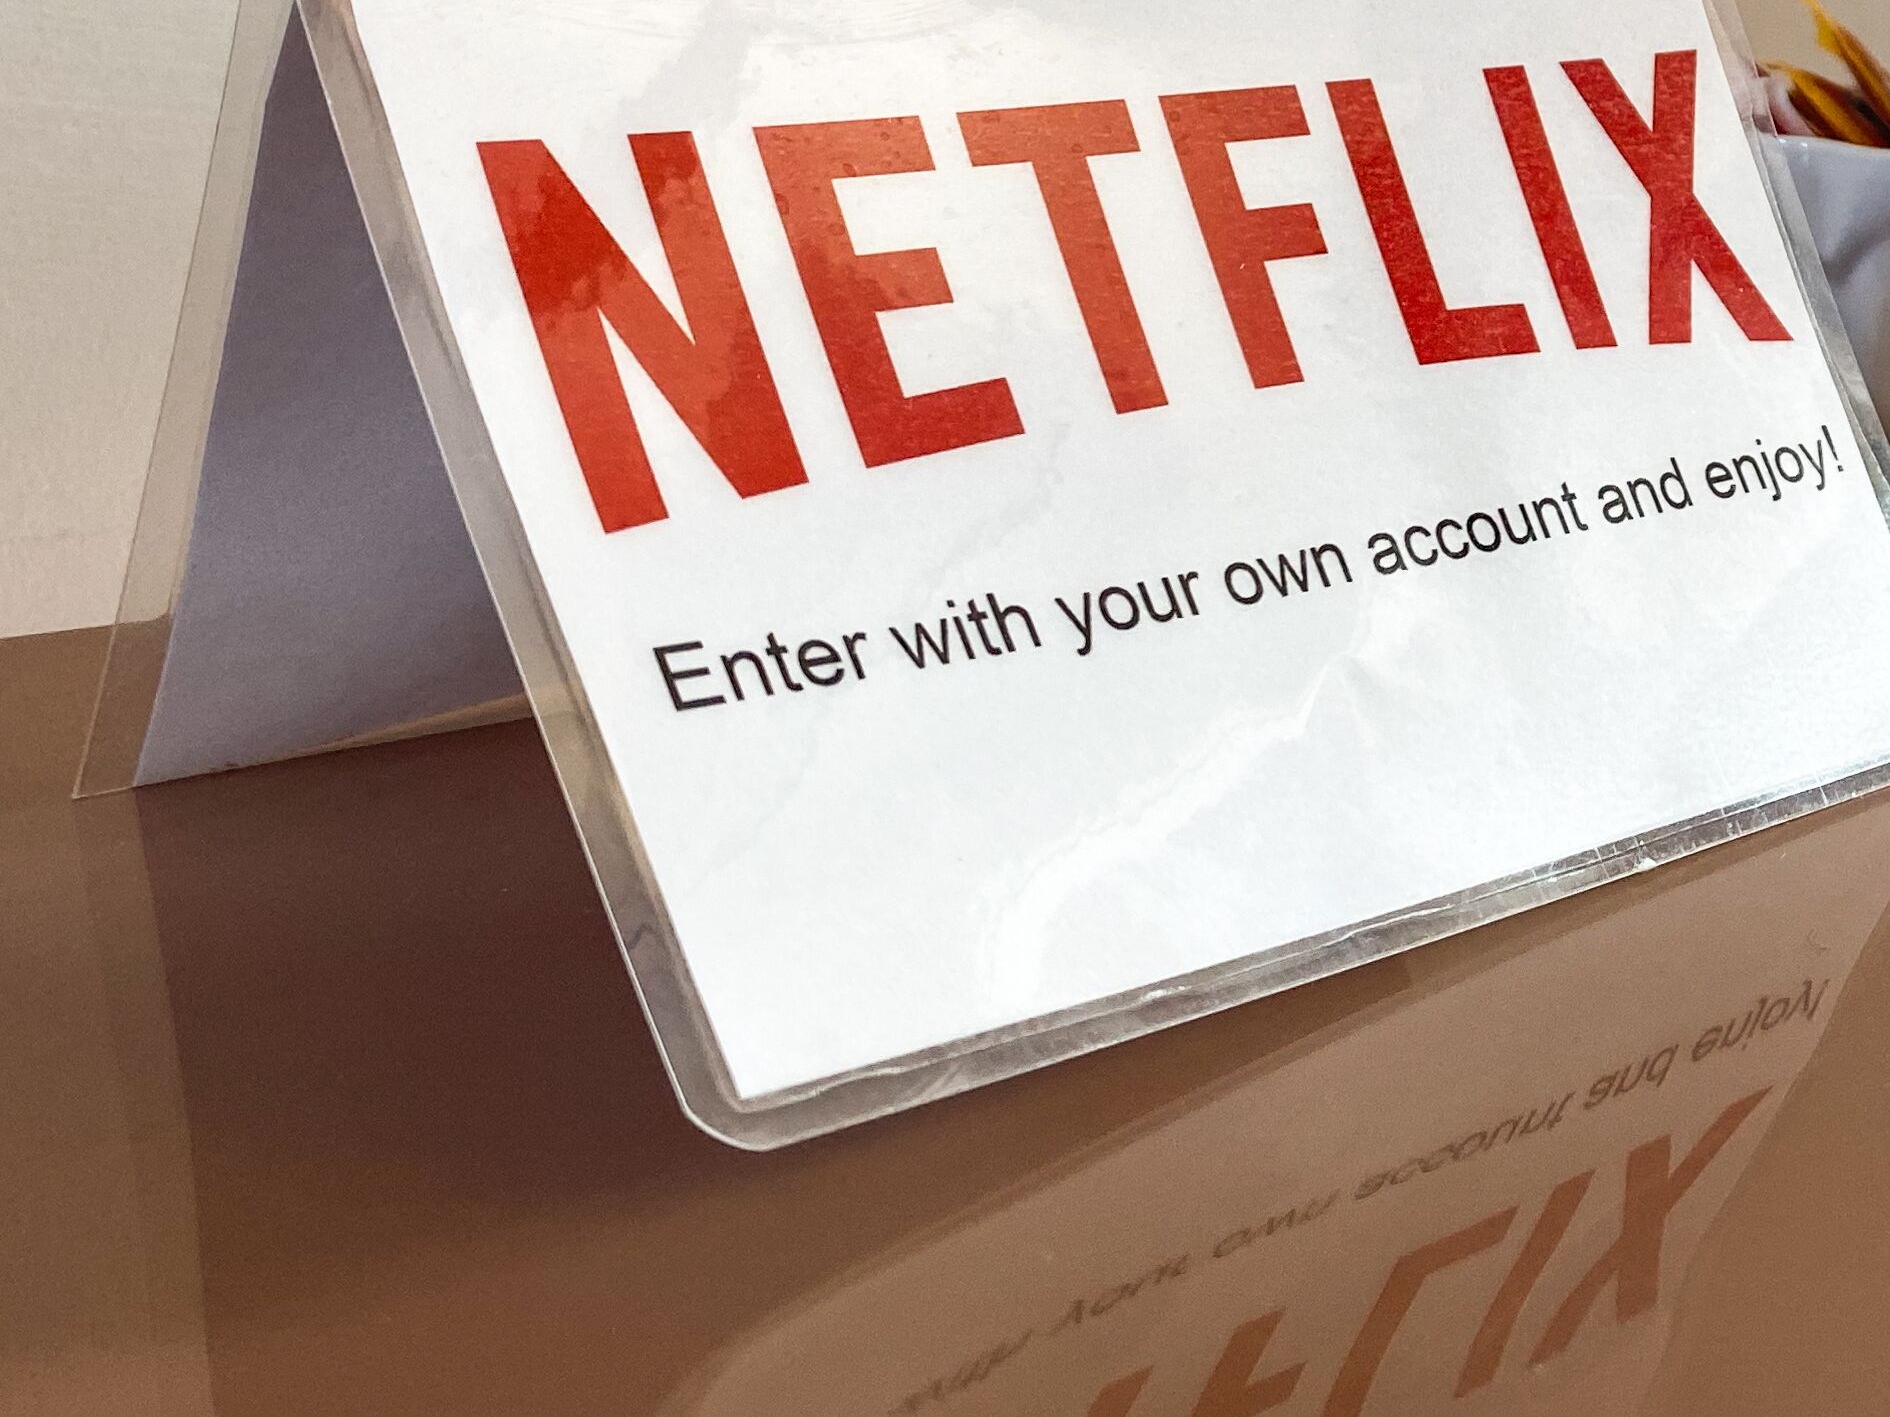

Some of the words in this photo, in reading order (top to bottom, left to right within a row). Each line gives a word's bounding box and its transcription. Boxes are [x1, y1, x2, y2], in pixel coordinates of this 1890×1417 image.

[476, 50, 1792, 535] NETFLIX
[652, 632, 868, 712] Enter
[888, 592, 1042, 670] with
[1054, 571, 1201, 658] your
[1224, 543, 1353, 605] own
[1367, 482, 1589, 575] account
[1597, 456, 1694, 524] and
[1705, 424, 1839, 502] enjoy!
